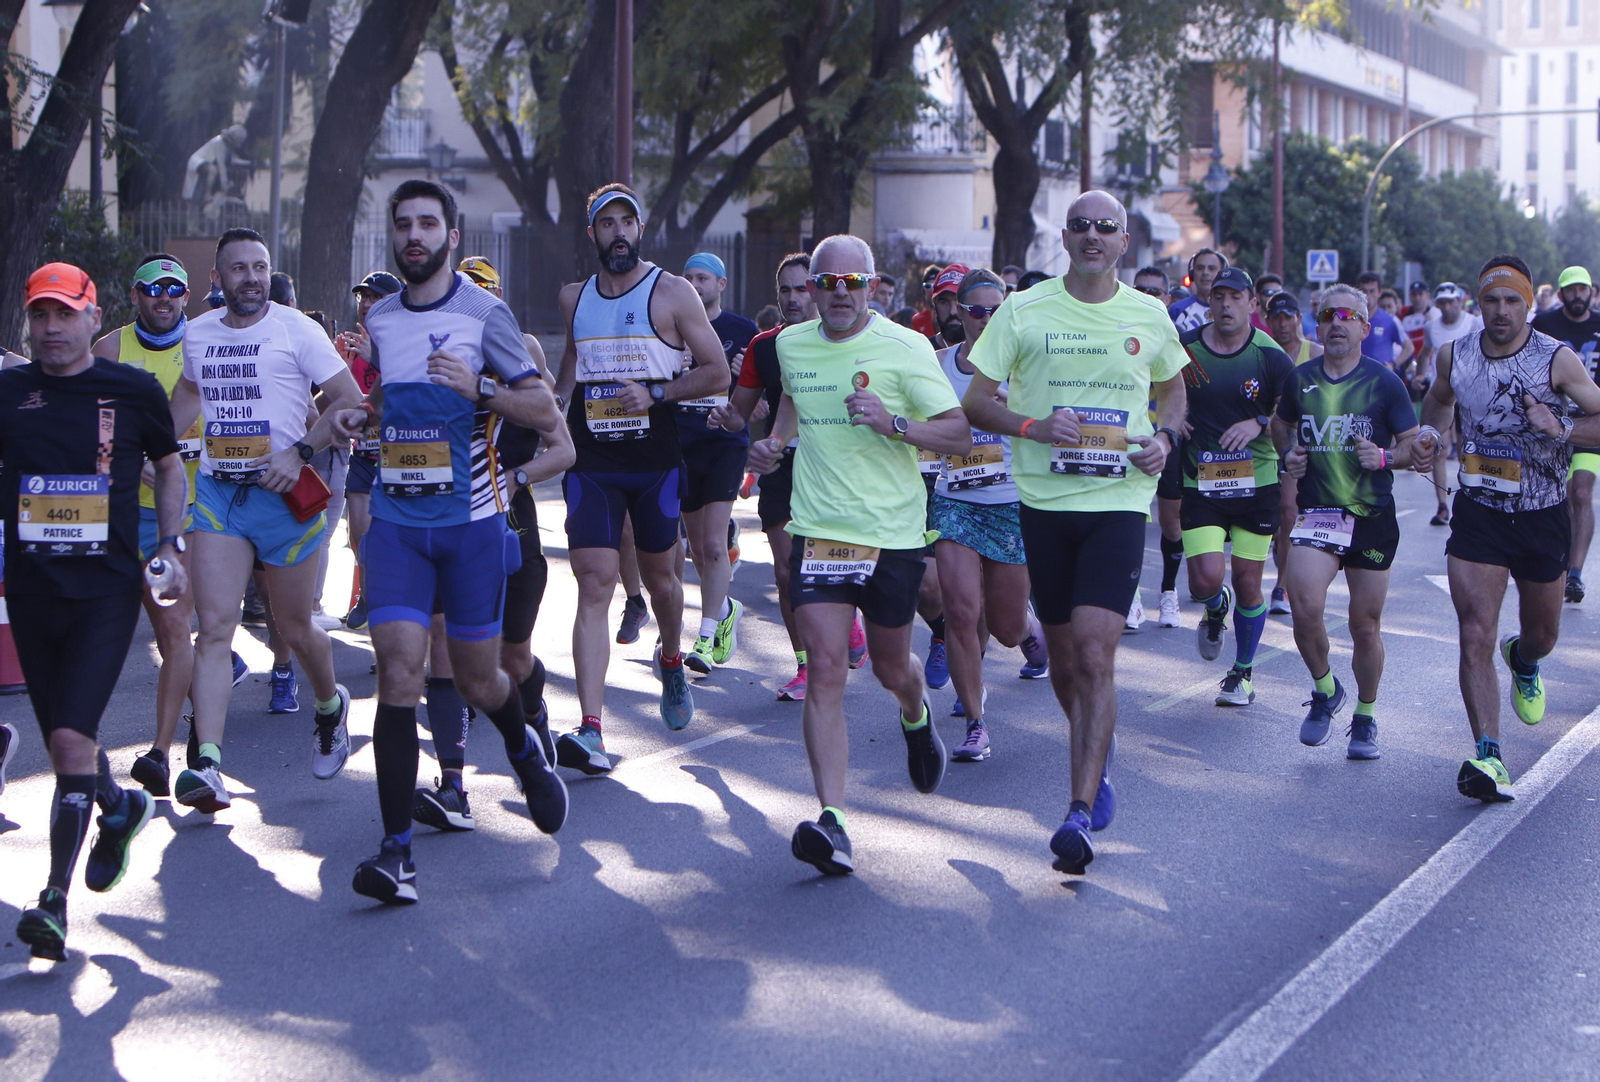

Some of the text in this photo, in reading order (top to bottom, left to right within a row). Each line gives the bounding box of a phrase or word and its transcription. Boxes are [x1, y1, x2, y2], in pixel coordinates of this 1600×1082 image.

[205, 344, 261, 358] IN MEMORIAM
[591, 342, 647, 354] fisioterapia
[217, 364, 240, 378] CRESPO
[242, 363, 257, 378] BIEL
[800, 385, 837, 393] GUERREIRO
[1048, 380, 1087, 388] MARATÓN
[1088, 381, 1117, 389] SEVILLA
[245, 384, 262, 400] BOAL
[216, 405, 252, 419] 12-01-10
[592, 420, 642, 430] JOSE ROMERO
[821, 417, 847, 425] SEVILLA
[223, 425, 261, 434] ZURICH
[398, 429, 439, 440] ZURICH
[224, 447, 250, 457] 5757
[1058, 451, 1121, 463] JORGE SEABRA
[1214, 452, 1246, 461] ZURICH
[1478, 446, 1513, 458] ZURICH
[399, 454, 427, 466] 4853
[962, 454, 984, 466] 6167
[217, 461, 242, 470] SERGIO
[1478, 464, 1502, 476] 4664
[401, 472, 426, 481] MIKEL
[962, 467, 986, 478] NICOLE
[1215, 469, 1237, 478] 4907
[47, 480, 98, 491] ZURICH
[1214, 480, 1239, 489] CARLES
[1481, 477, 1497, 488] NICK
[46, 508, 80, 521] 4401
[1314, 521, 1337, 530] 7598
[43, 528, 83, 538] PATRICE
[1312, 530, 1329, 540] AUTI
[828, 548, 856, 558] 4491
[806, 562, 824, 572] LUÍS
